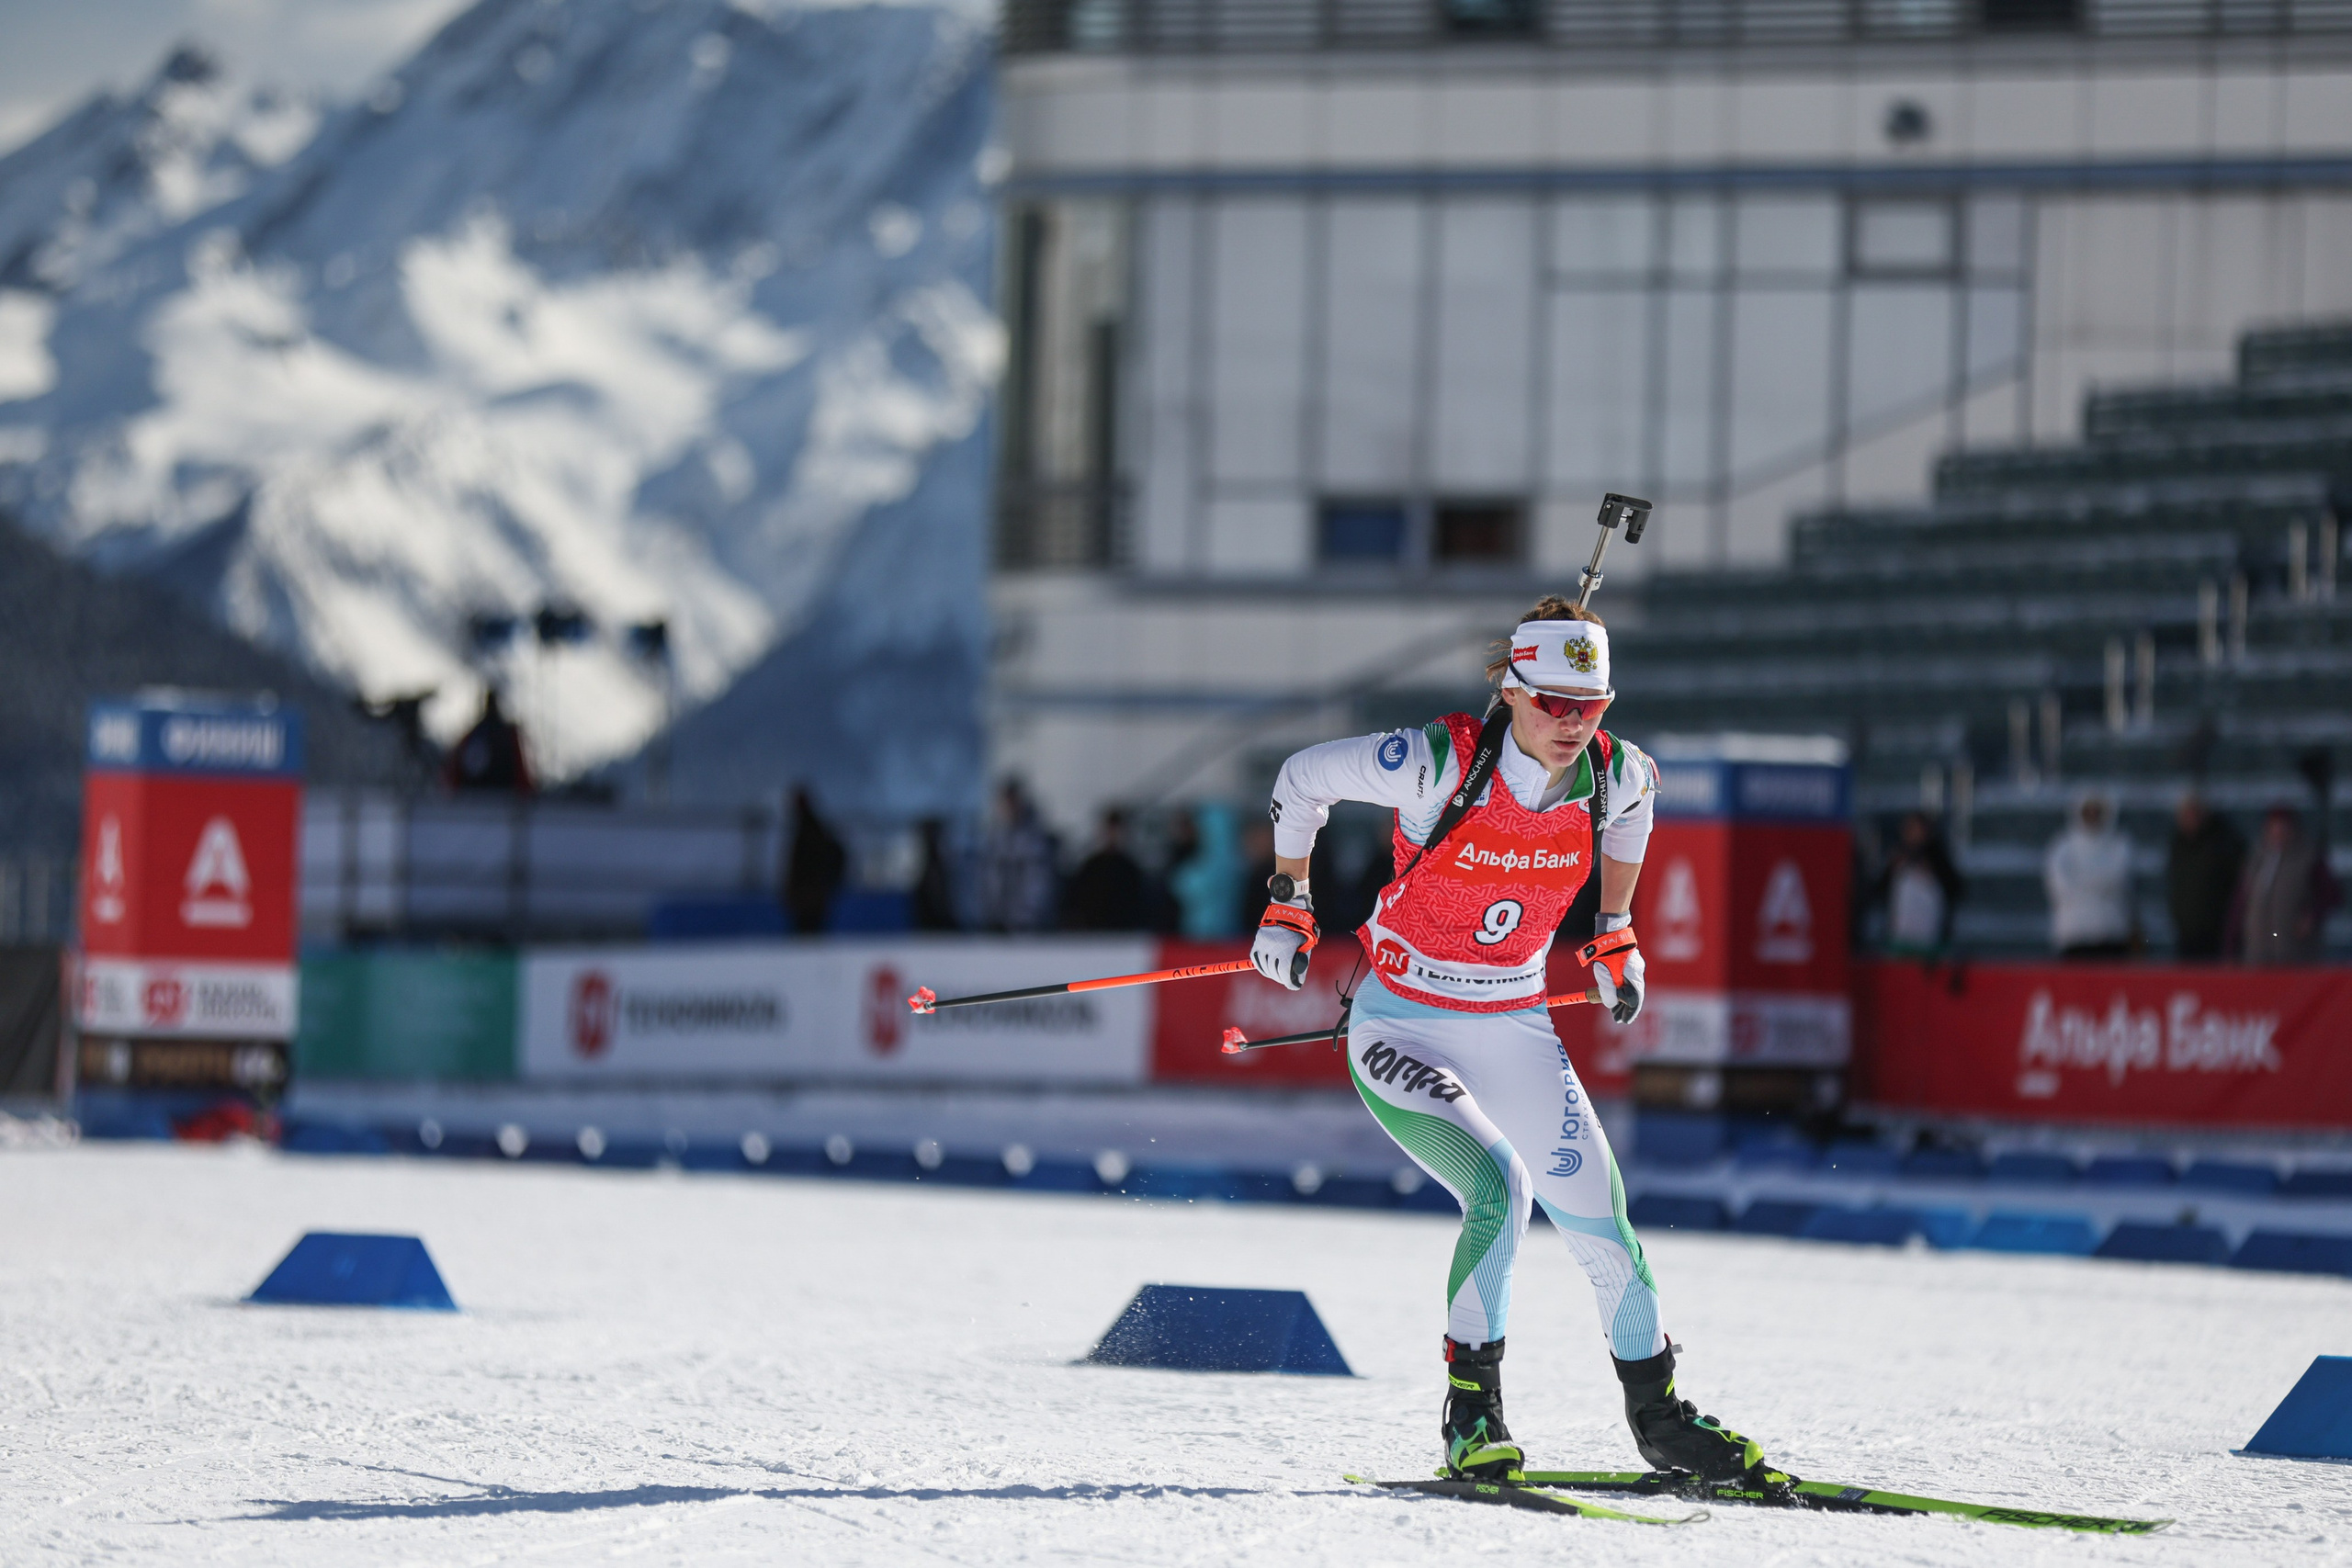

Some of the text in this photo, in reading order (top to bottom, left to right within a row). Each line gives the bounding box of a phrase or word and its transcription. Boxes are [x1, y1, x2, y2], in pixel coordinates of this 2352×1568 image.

[1417, 765, 1427, 795] CRAFT
[1454, 842, 1580, 873] Альфа Банк
[1474, 899, 1523, 945] 9
[2167, 990, 2280, 1072] Банк
[1557, 1043, 1580, 1140] ЮГОРИЯ
[1476, 1483, 1499, 1495] FISCHER
[1716, 1489, 1764, 1500] FISCHER
